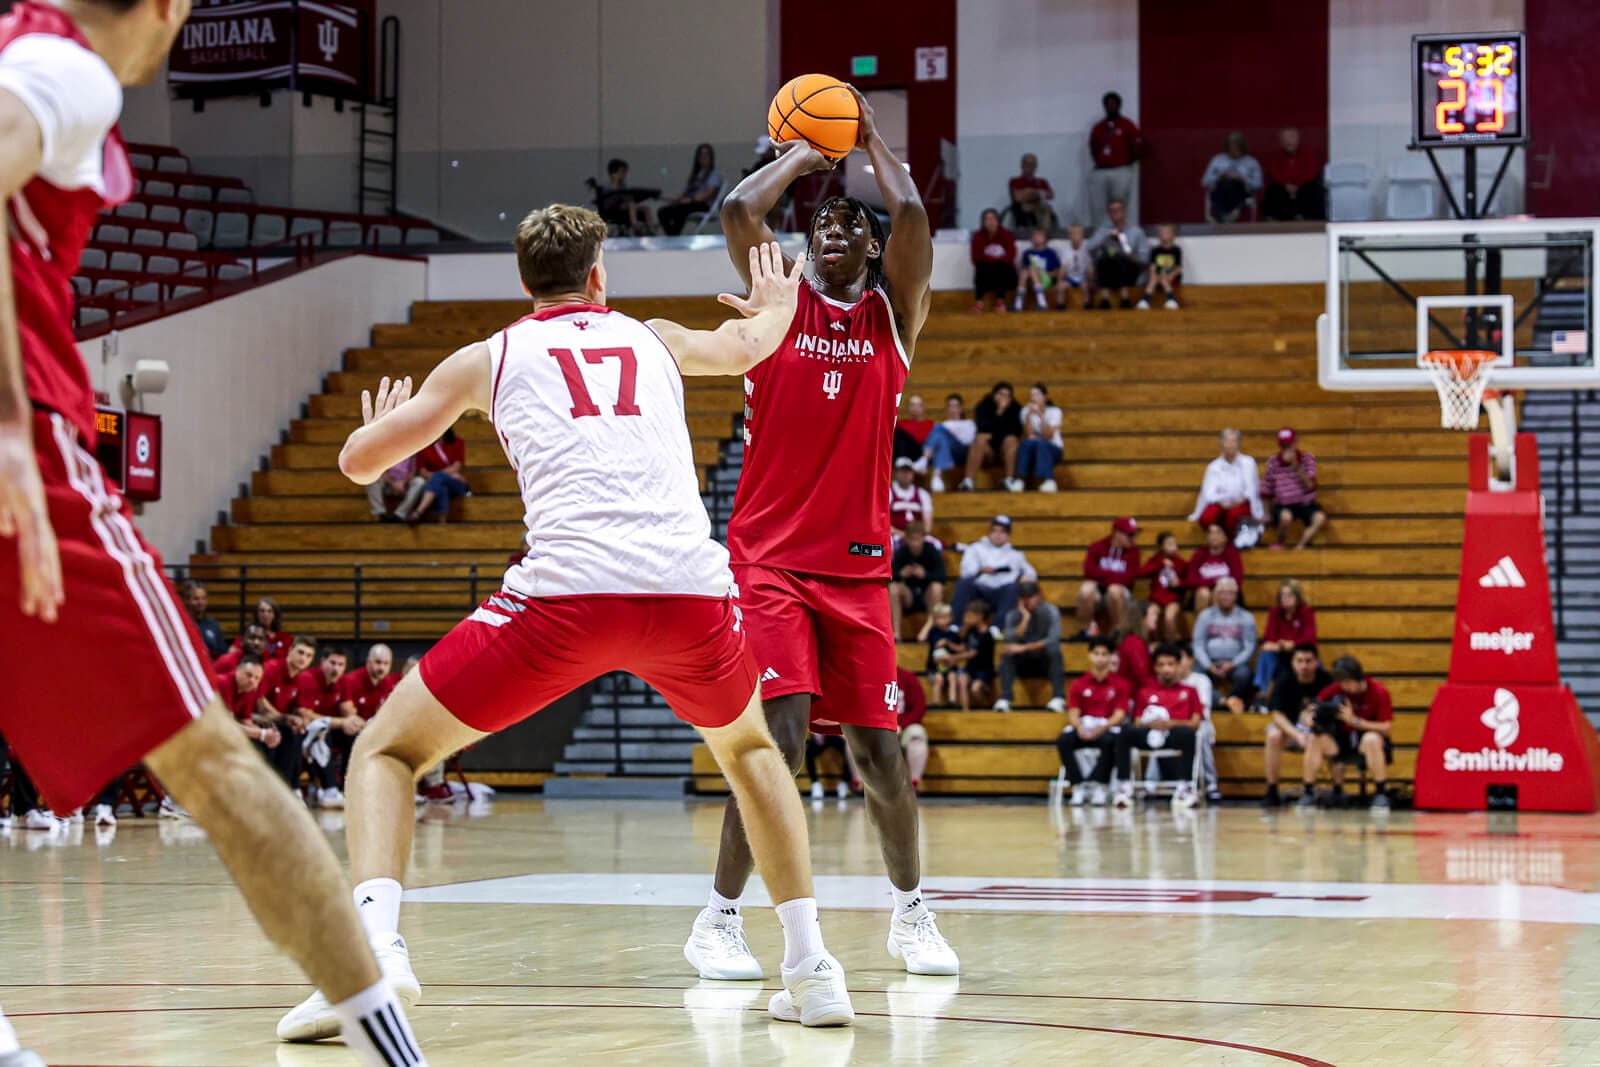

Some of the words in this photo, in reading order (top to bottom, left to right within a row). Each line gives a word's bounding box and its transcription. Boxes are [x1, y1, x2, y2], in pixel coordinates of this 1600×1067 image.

[183, 17, 277, 49] INDIANA
[926, 59, 937, 75] 5
[1445, 45, 1513, 77] 5:32
[795, 333, 874, 357] INDIANA
[547, 347, 642, 419] 17
[1470, 627, 1535, 655] meijer
[1443, 747, 1564, 772] Smithville
